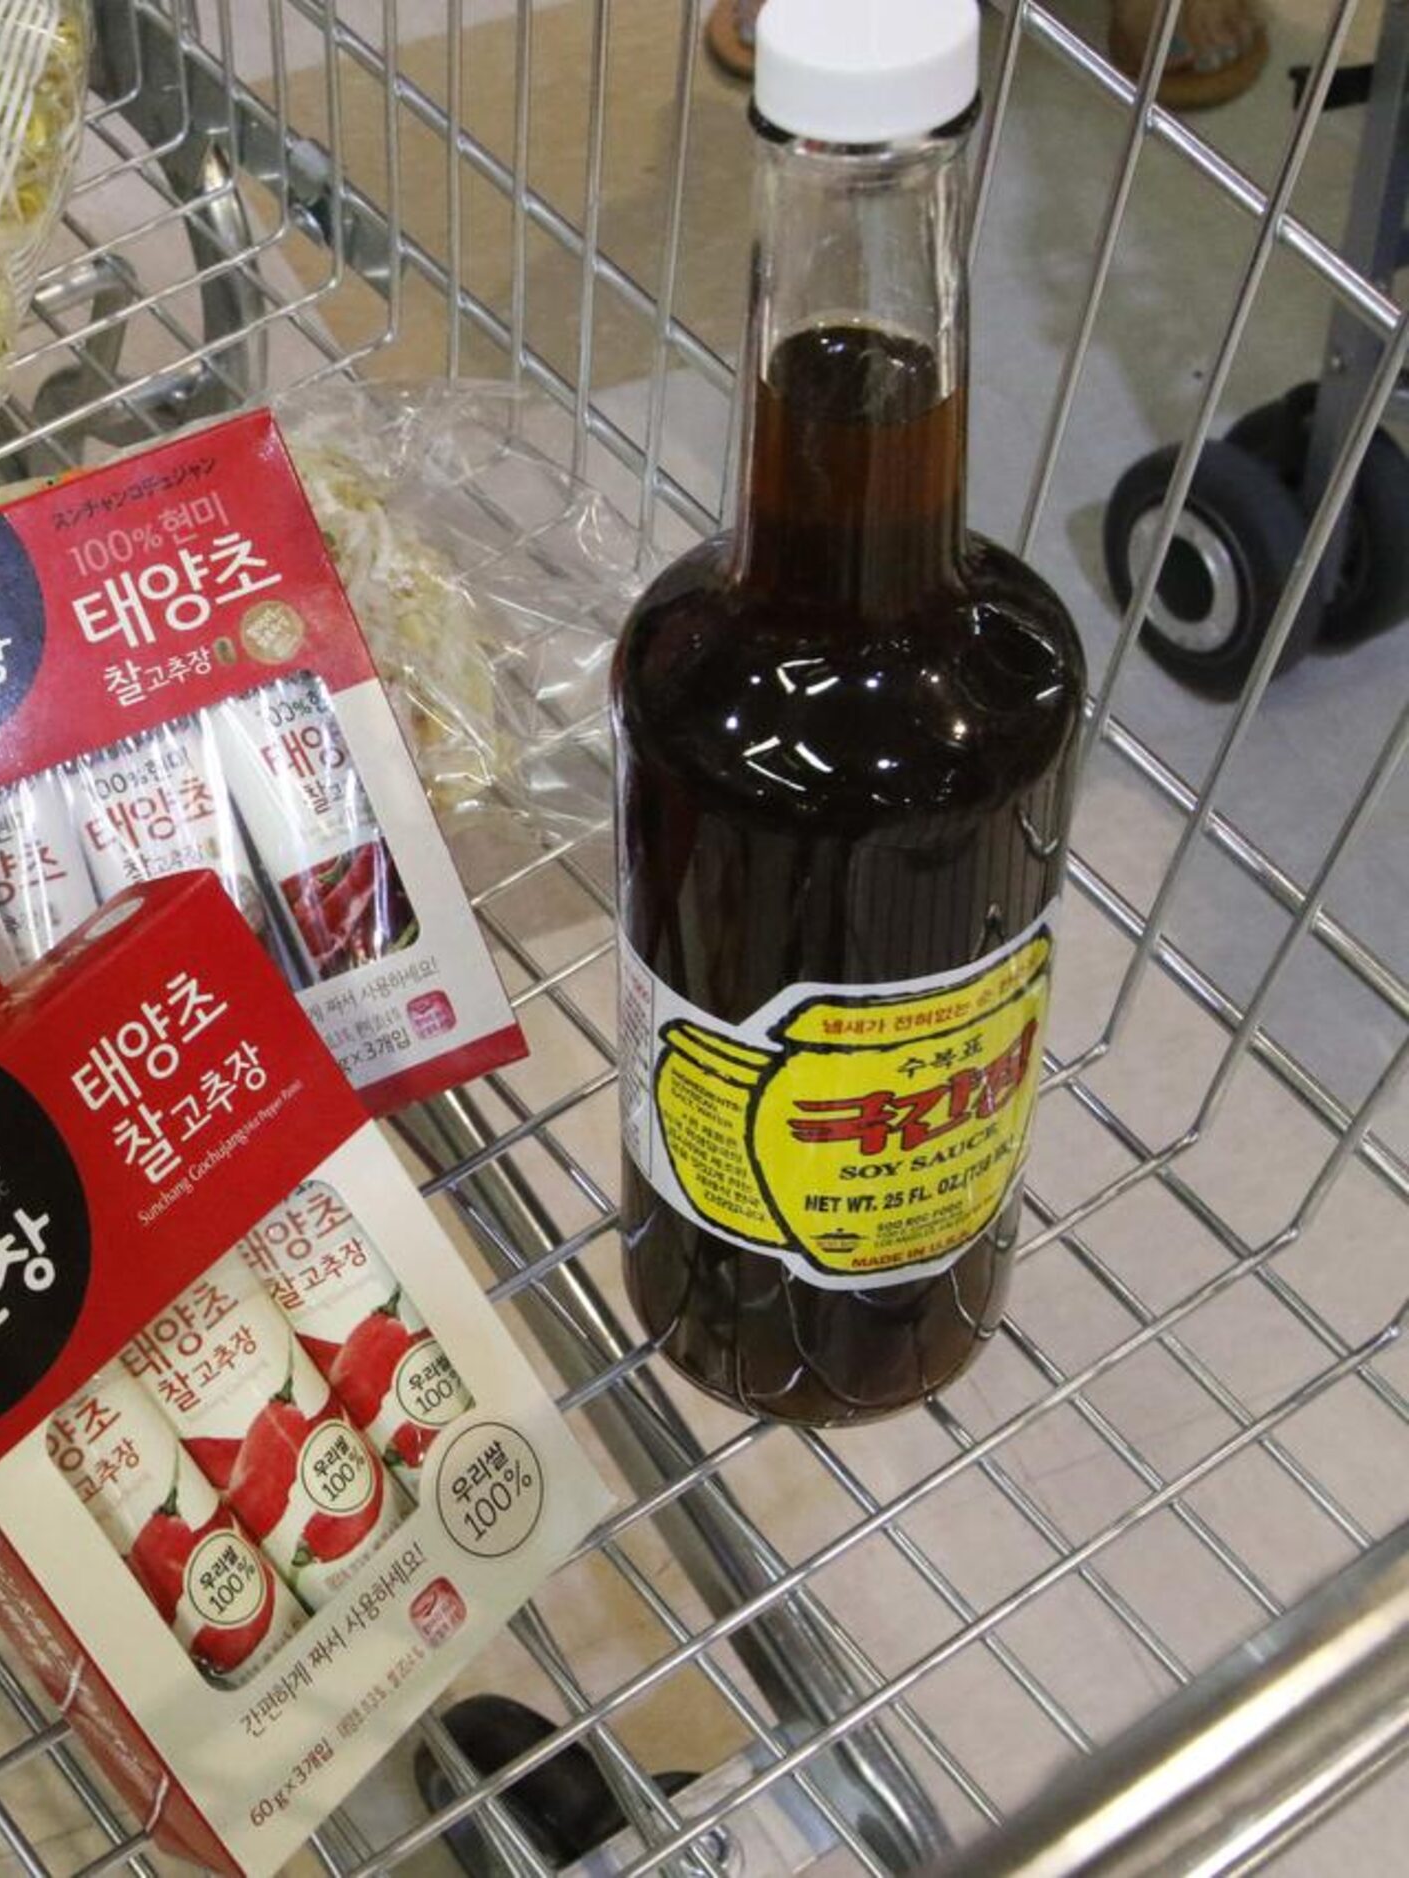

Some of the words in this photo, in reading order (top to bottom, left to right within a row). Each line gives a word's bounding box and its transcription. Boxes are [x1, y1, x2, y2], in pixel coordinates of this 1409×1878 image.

[72, 532, 282, 648] 태양초
[70, 971, 229, 1111] 태양초
[112, 1040, 267, 1185] 찰고추장
[839, 1160, 905, 1181] SOY
[909, 1123, 1000, 1172] SAUCE
[137, 1175, 194, 1227] Sunchang
[804, 1194, 842, 1213] NET
[845, 1194, 878, 1214] WT.
[882, 1191, 905, 1211] 25
[907, 1185, 933, 1206] FL.
[265, 1236, 368, 1311] 찰고추장
[851, 1250, 902, 1268] MADE
[906, 1246, 926, 1258] IN
[119, 1282, 239, 1377] 태양초
[157, 1323, 258, 1413] 찰고추장
[312, 1434, 351, 1477] 우리쌀
[321, 1441, 367, 1502] 100%
[451, 1439, 510, 1504] 우리쌀
[462, 1460, 533, 1542] 100%
[199, 1544, 239, 1590] 우리쌀
[207, 1550, 257, 1616] 100%
[239, 1663, 314, 1738] 간편하게
[308, 1626, 347, 1668] 짜서
[344, 1541, 427, 1622] 사용하세요!
